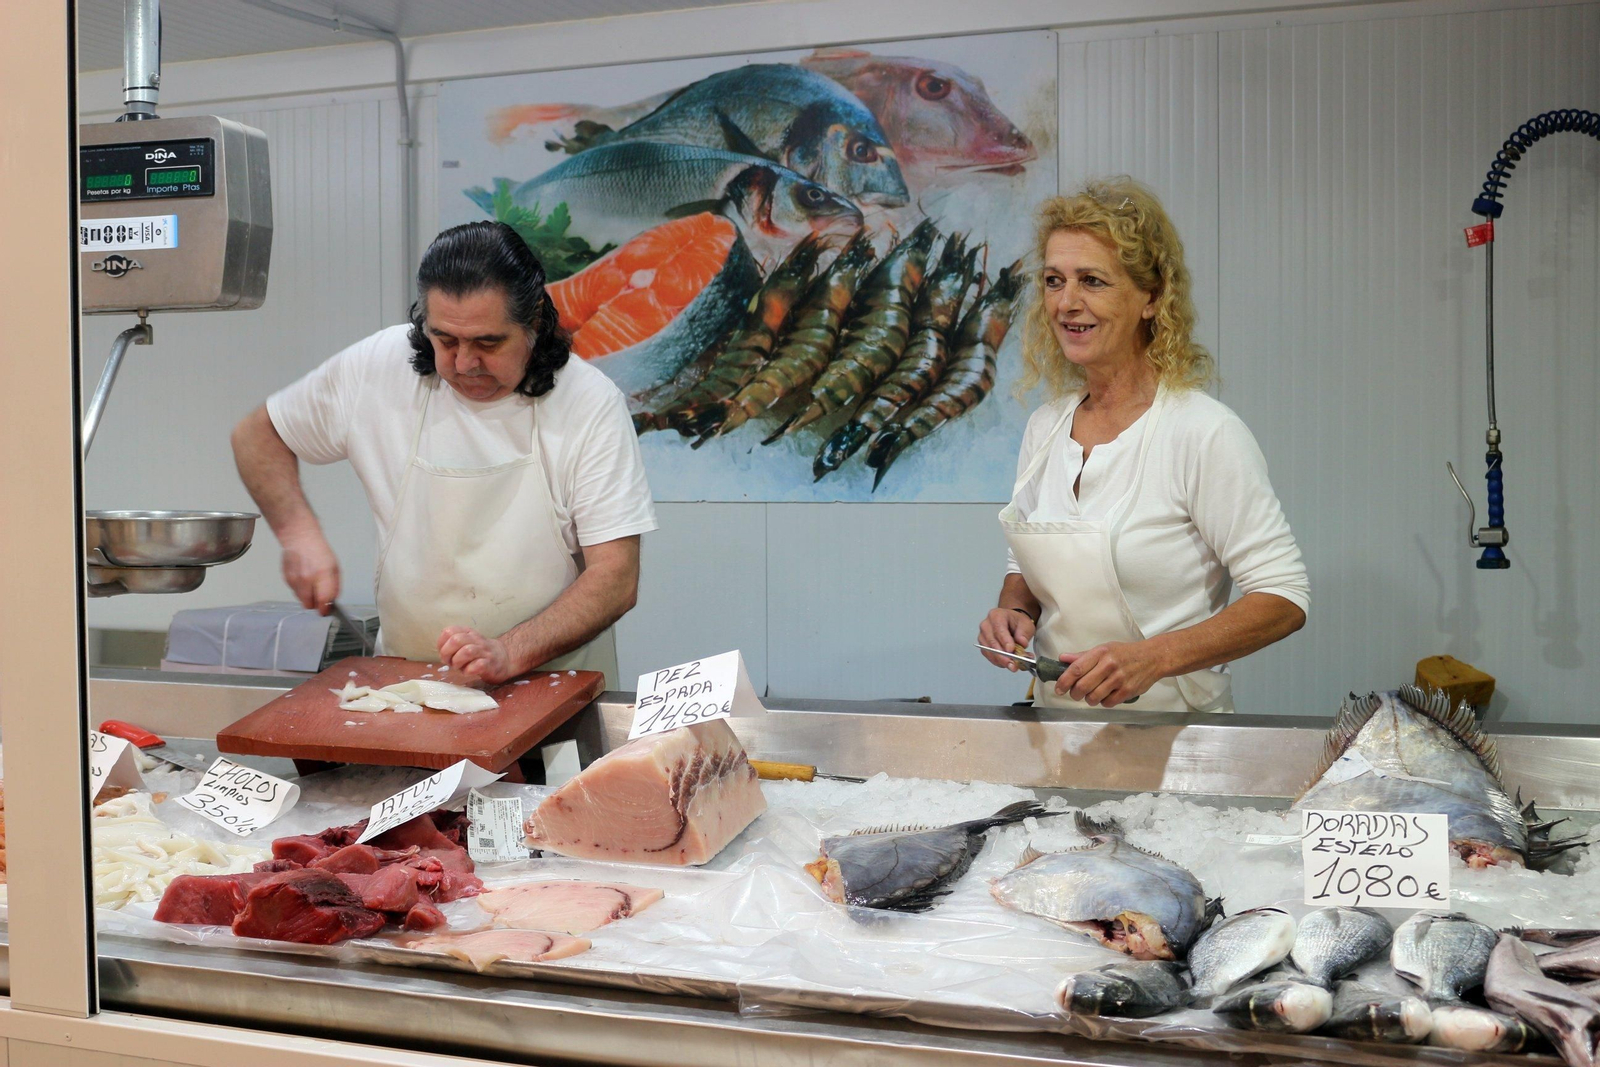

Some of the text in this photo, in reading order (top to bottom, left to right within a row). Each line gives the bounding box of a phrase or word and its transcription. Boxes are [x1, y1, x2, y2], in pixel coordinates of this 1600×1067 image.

[145, 150, 177, 161] DINA
[86, 188, 109, 196] Pesetas
[123, 187, 131, 195] kg
[146, 183, 200, 194] Importe Ptas
[91, 258, 143, 273] DINA
[638, 680, 713, 710] ESPADA
[203, 780, 249, 806] LIMPIOS
[379, 772, 443, 819] ATUN
[1301, 812, 1429, 847] DORADAS
